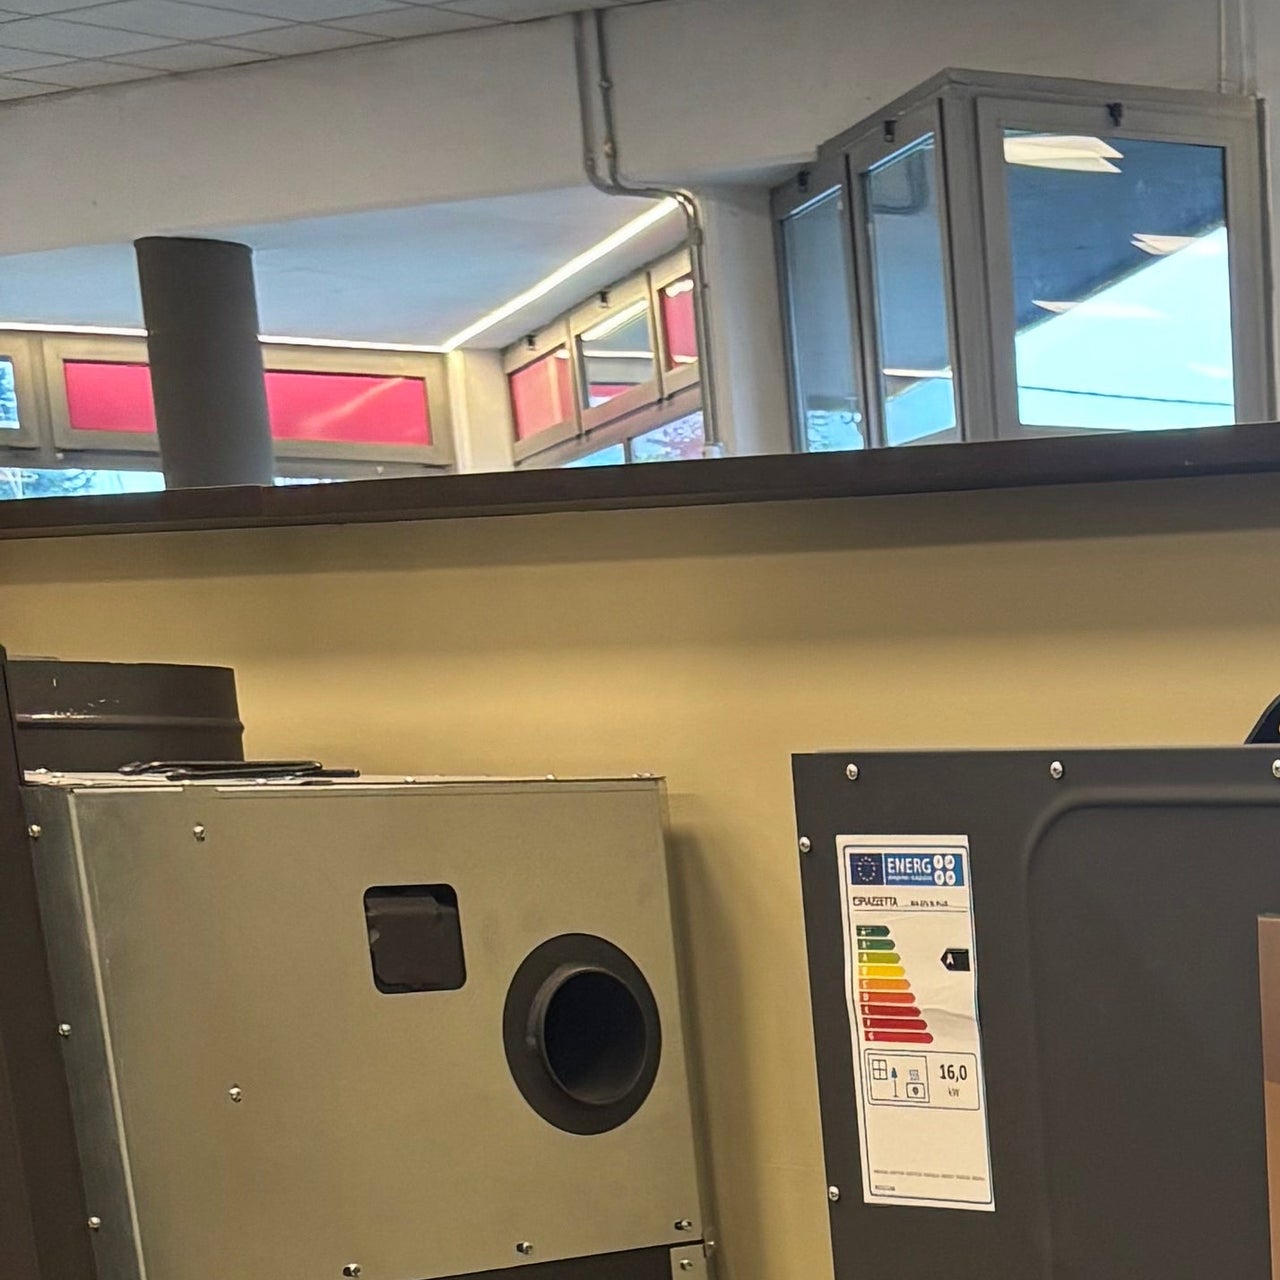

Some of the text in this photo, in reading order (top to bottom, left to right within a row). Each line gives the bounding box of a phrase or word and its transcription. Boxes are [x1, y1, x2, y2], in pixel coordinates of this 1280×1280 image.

[887, 858, 931, 873] ENERG
[946, 952, 954, 964] A
[940, 1064, 967, 1082] 16,0
